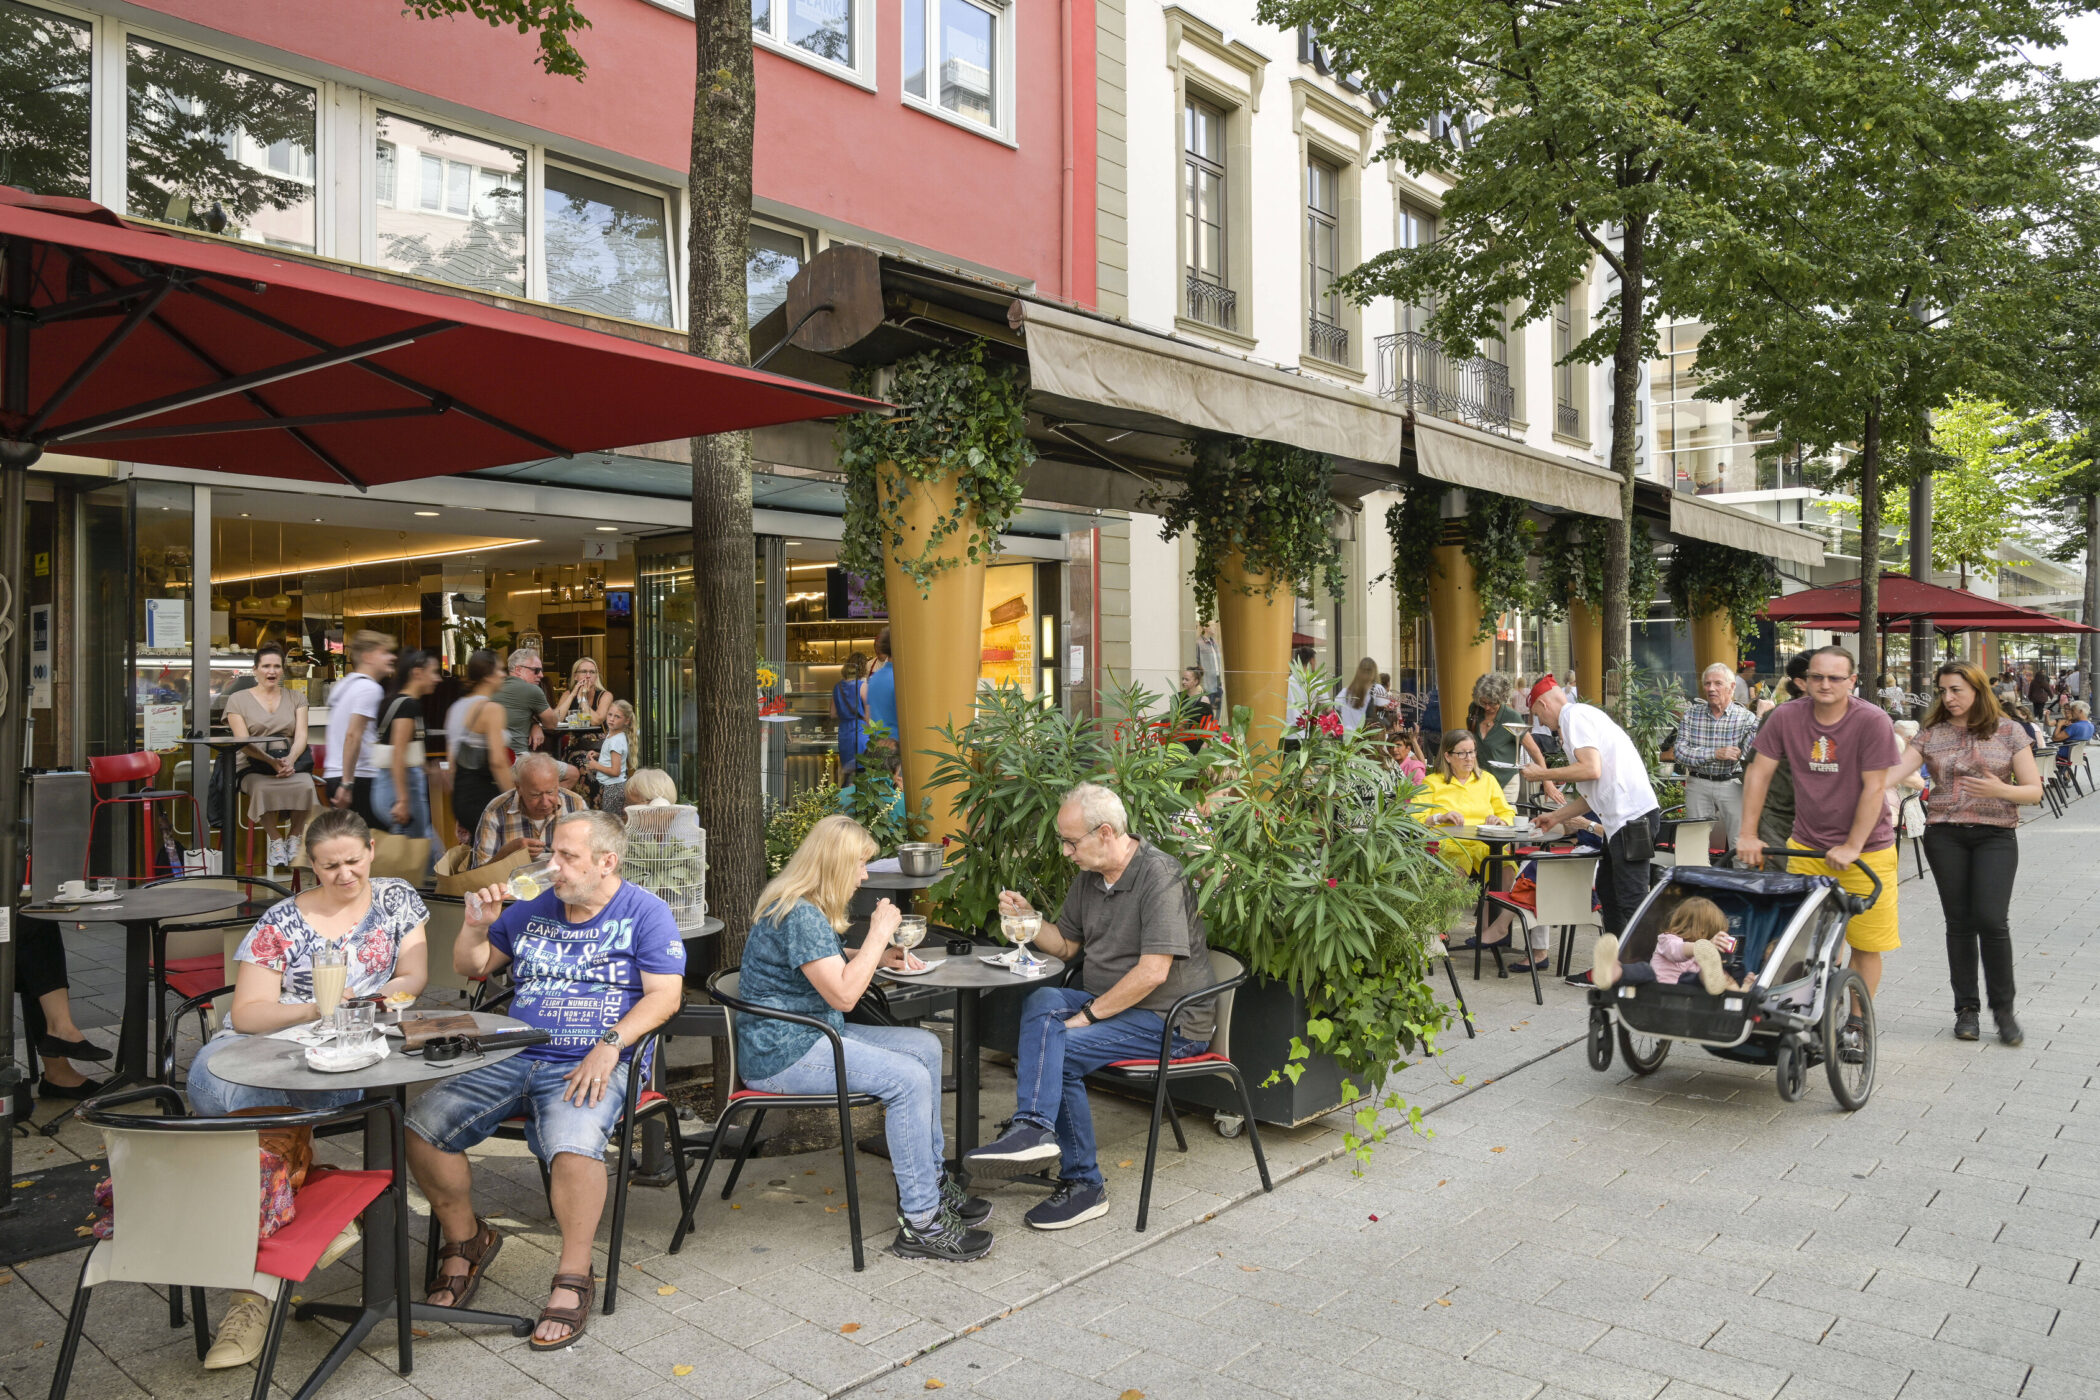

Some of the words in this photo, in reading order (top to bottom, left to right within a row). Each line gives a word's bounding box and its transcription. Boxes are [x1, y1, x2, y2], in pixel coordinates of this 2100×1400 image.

[526, 921, 559, 938] CAMP
[598, 918, 634, 953] 25
[541, 999, 565, 1007] FLIGHT
[567, 999, 601, 1007] NUMBER:
[538, 1009, 558, 1017] C.63
